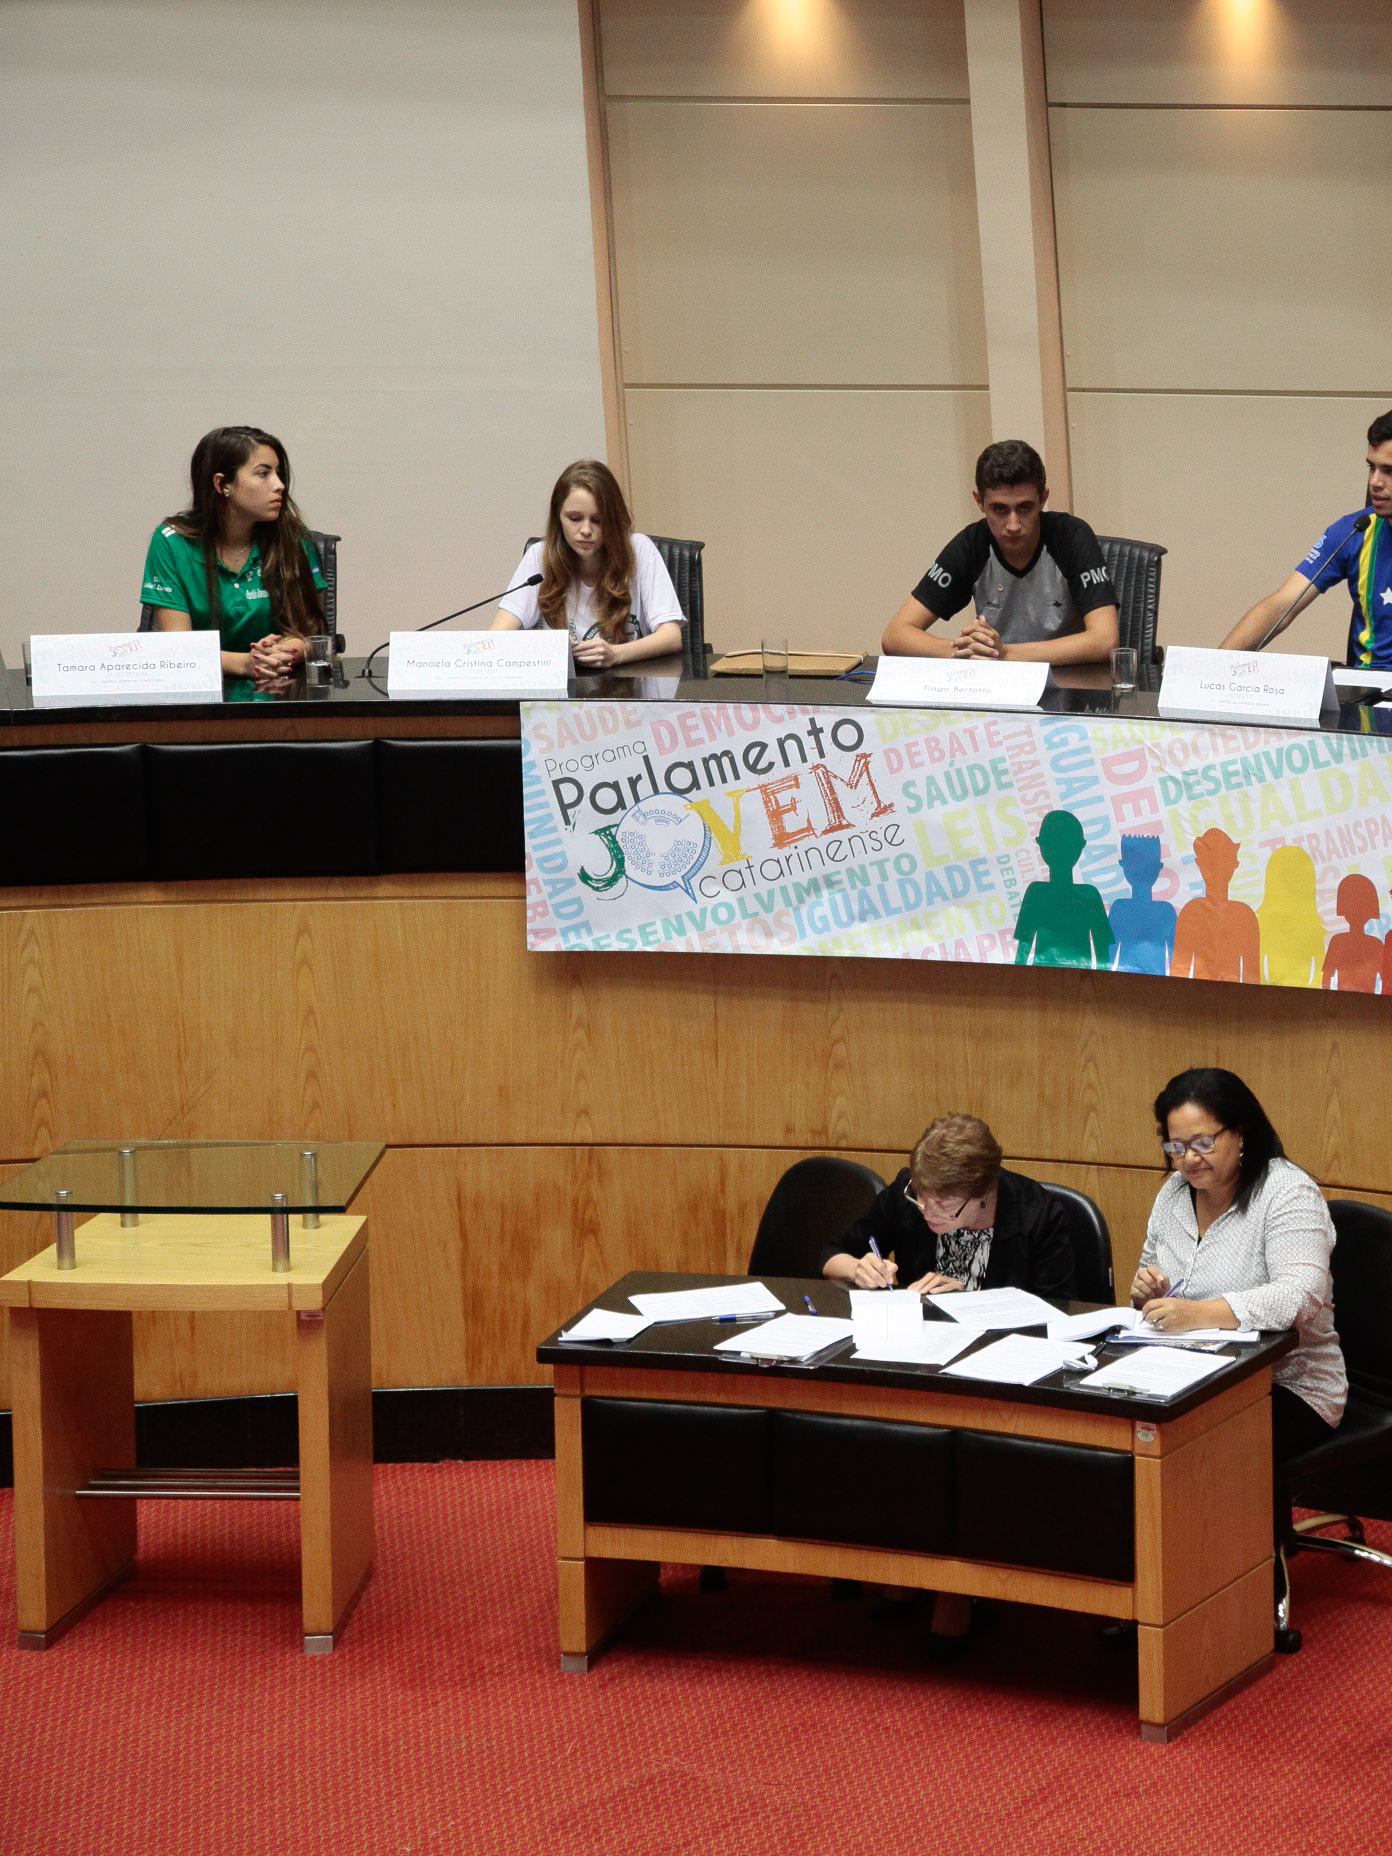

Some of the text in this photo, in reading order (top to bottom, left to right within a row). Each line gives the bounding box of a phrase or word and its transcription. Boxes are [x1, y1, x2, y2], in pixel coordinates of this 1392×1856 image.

[927, 562, 952, 588] MO
[56, 659, 197, 673] Tamara Aparecida Ribeiro
[406, 658, 552, 669] Manoela Cristina Campestini
[923, 684, 951, 694] Tiago
[1199, 680, 1286, 695] Lucas Garcia Rosa
[543, 739, 648, 779] Programa
[883, 720, 1004, 775] DEBATE
[551, 717, 864, 827] Parlamento
[902, 756, 1015, 814] SAÚDE
[913, 796, 1029, 869] LEIS
[698, 823, 905, 898] catarinense
[792, 857, 995, 940] IGUALDADE
